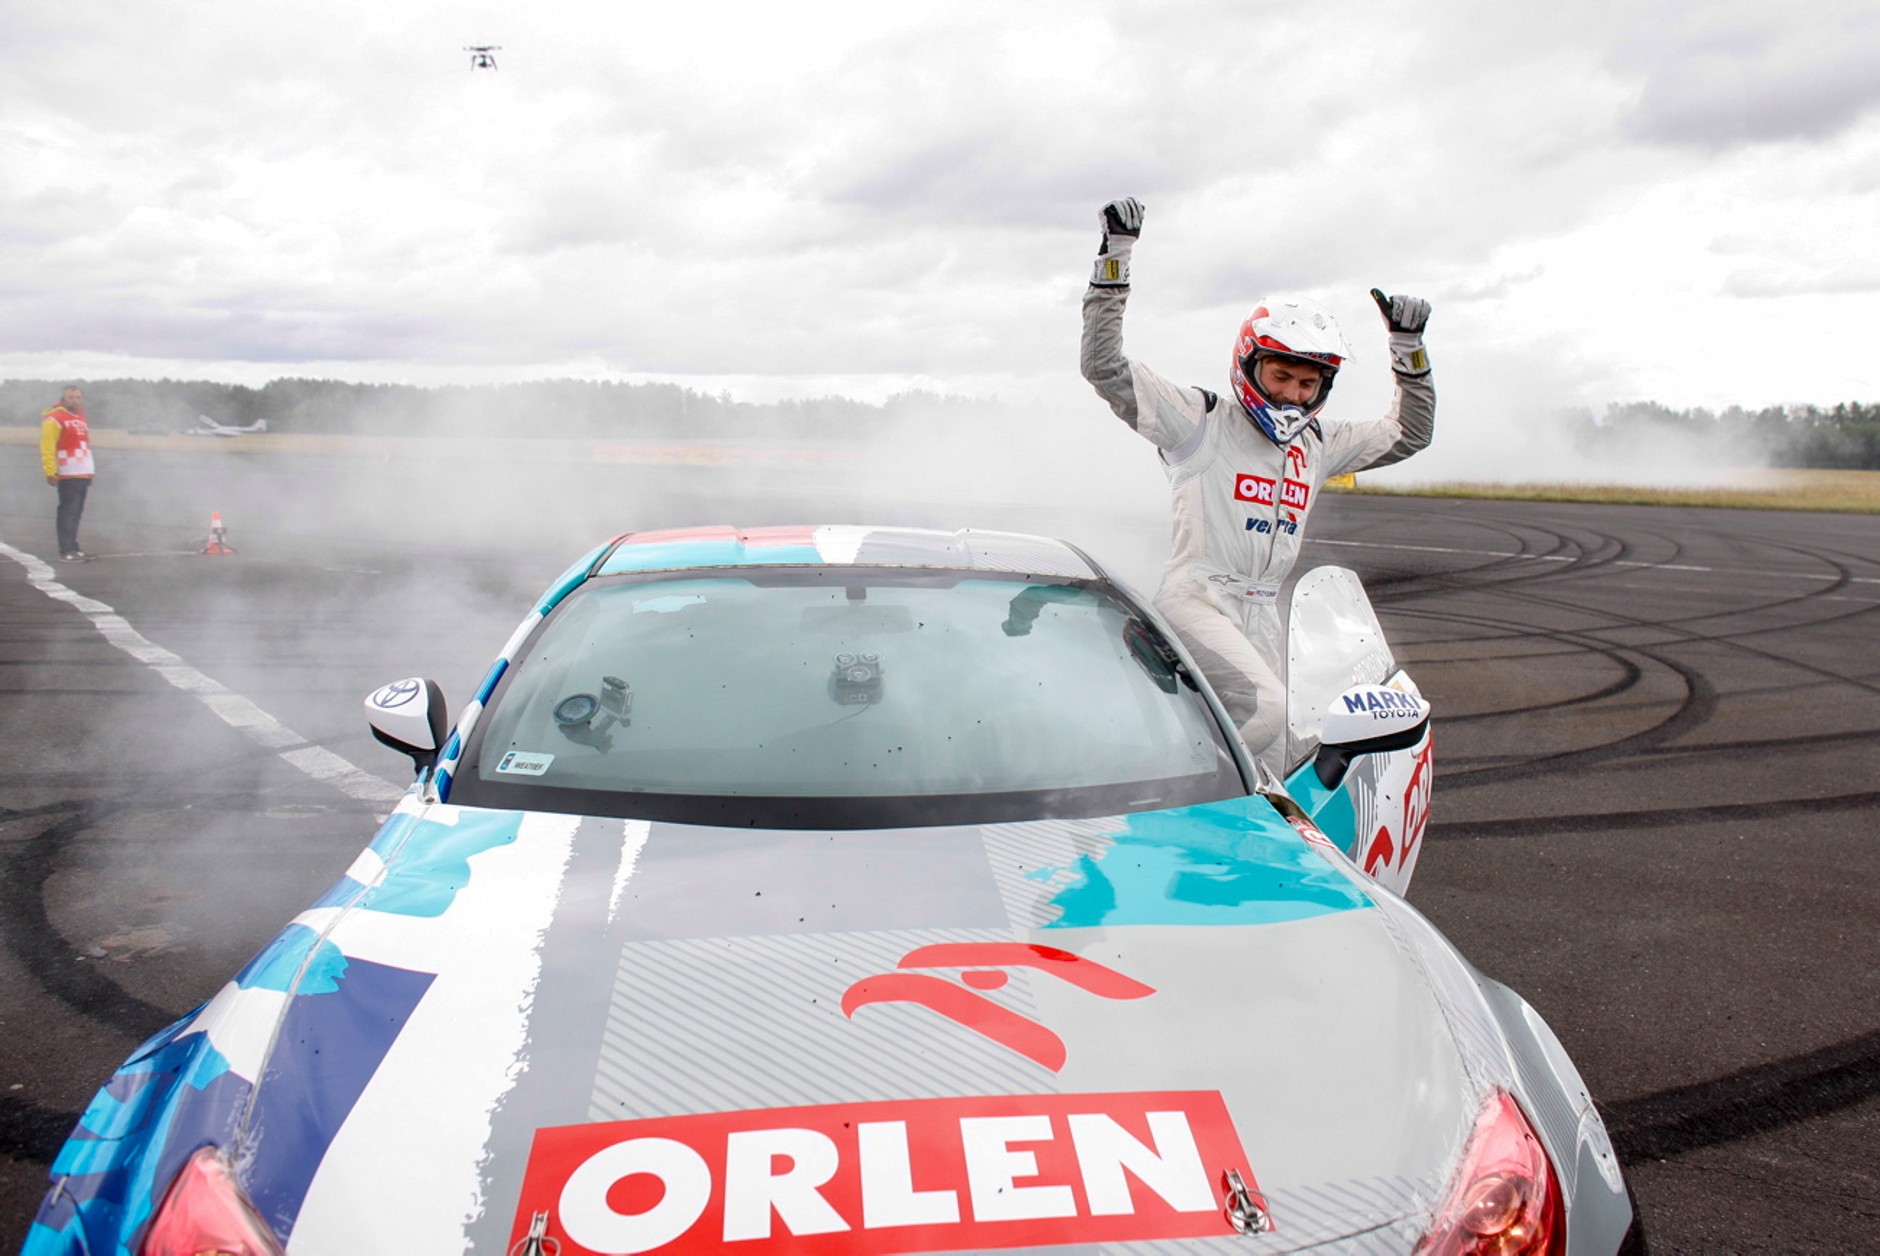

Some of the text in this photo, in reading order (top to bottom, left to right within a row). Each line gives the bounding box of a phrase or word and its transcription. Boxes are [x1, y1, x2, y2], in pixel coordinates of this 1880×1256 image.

[1239, 478, 1306, 506] ORLEN
[1342, 691, 1421, 714] MARKI
[1370, 709, 1419, 720] TOYOTA
[557, 1110, 1218, 1255] ORLEN
